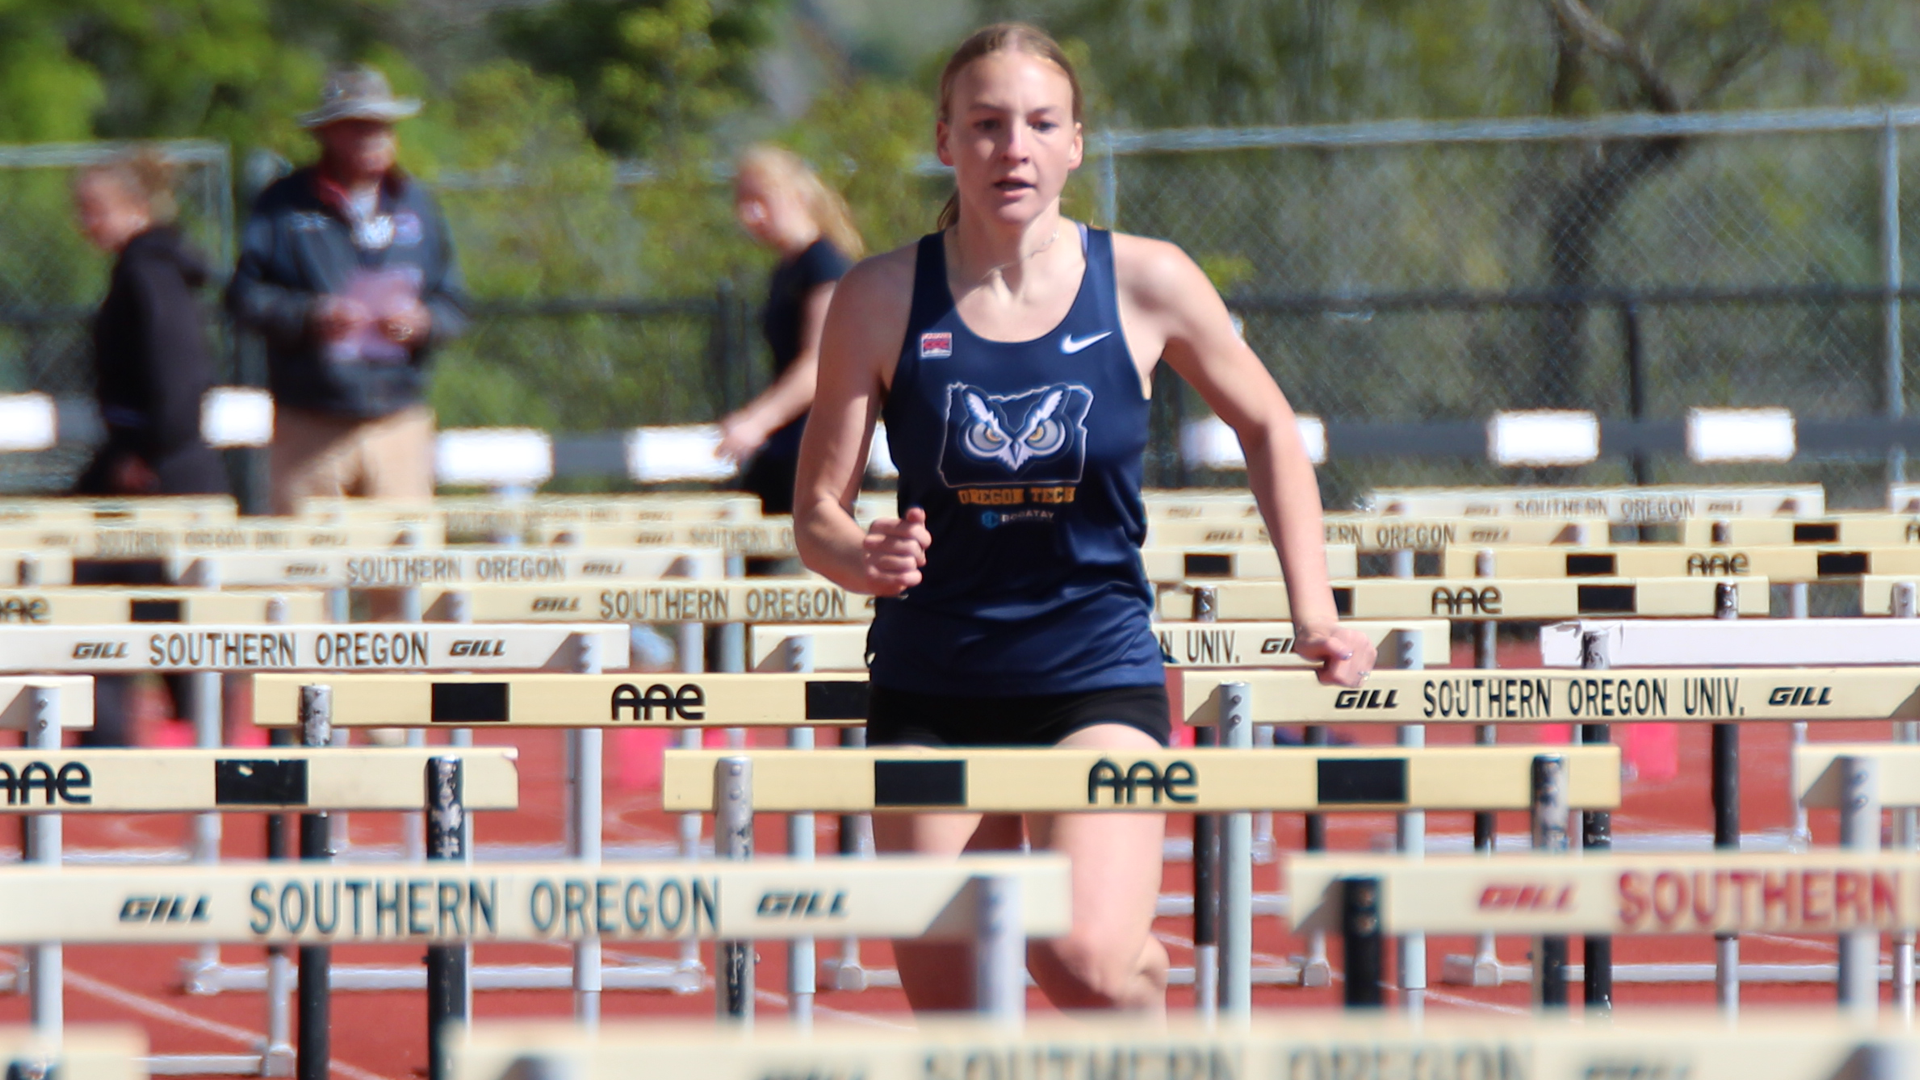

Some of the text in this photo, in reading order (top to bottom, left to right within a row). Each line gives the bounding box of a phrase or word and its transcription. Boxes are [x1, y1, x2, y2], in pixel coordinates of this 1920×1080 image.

[958, 487, 1076, 505] OREGON TECH
[1375, 523, 1457, 548] OREGON
[346, 556, 461, 583] SOUTHERN
[475, 556, 566, 582] OREGON
[599, 587, 730, 620] SOUTHERN
[745, 586, 847, 620] OREGON
[72, 631, 507, 667] GILL SOUTHERN OREGON GILL
[1186, 629, 1241, 664] UNIV.
[1334, 677, 1834, 718] GILL SOUTHERN OREGON UNIV. GILL
[118, 876, 849, 937] GILL SOUTHERN OREGON GILL
[1616, 868, 1900, 927] SOUTHERN
